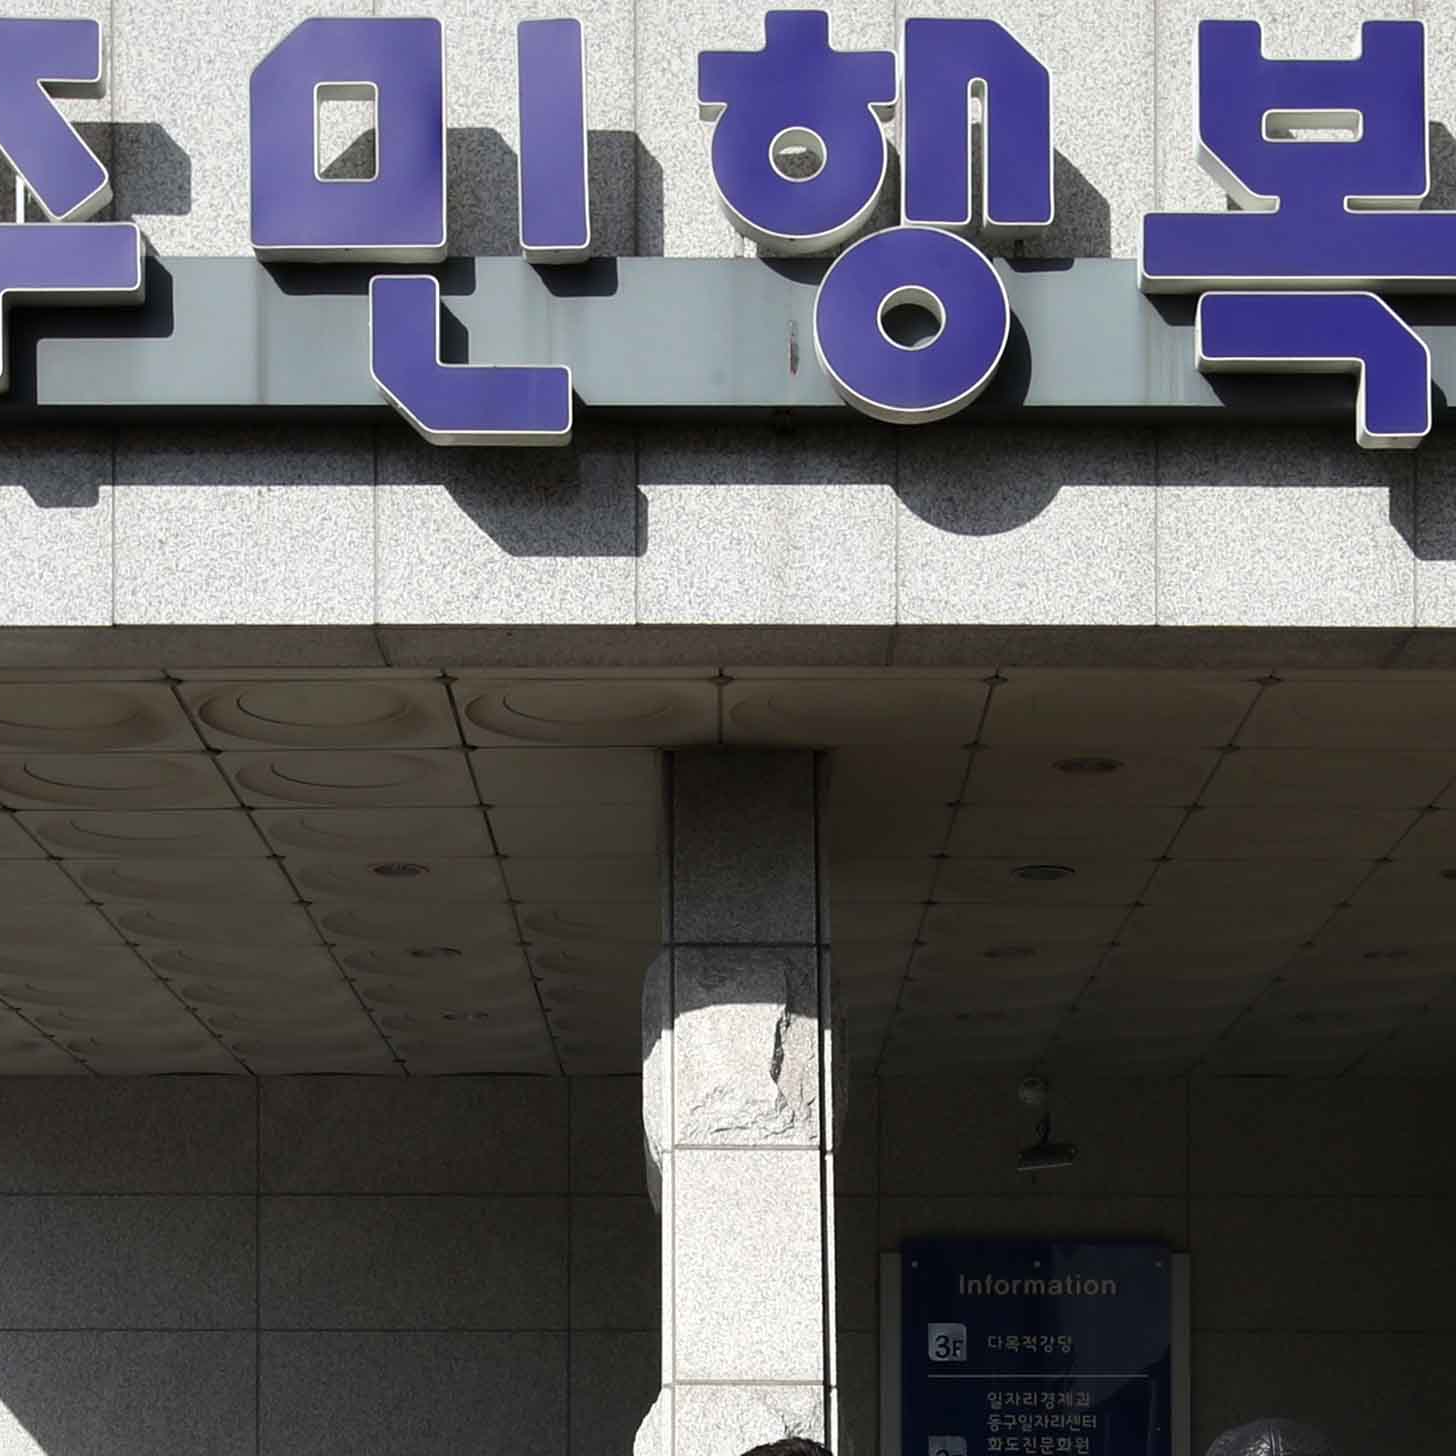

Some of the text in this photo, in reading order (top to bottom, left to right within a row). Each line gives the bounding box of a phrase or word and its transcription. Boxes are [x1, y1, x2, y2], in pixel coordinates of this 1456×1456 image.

[959, 1274, 1118, 1297] Information
[934, 1334, 963, 1358] 3F
[987, 1414, 1098, 1432] 동구일자리센터
[987, 1436, 1090, 1454] 화도진문화원
